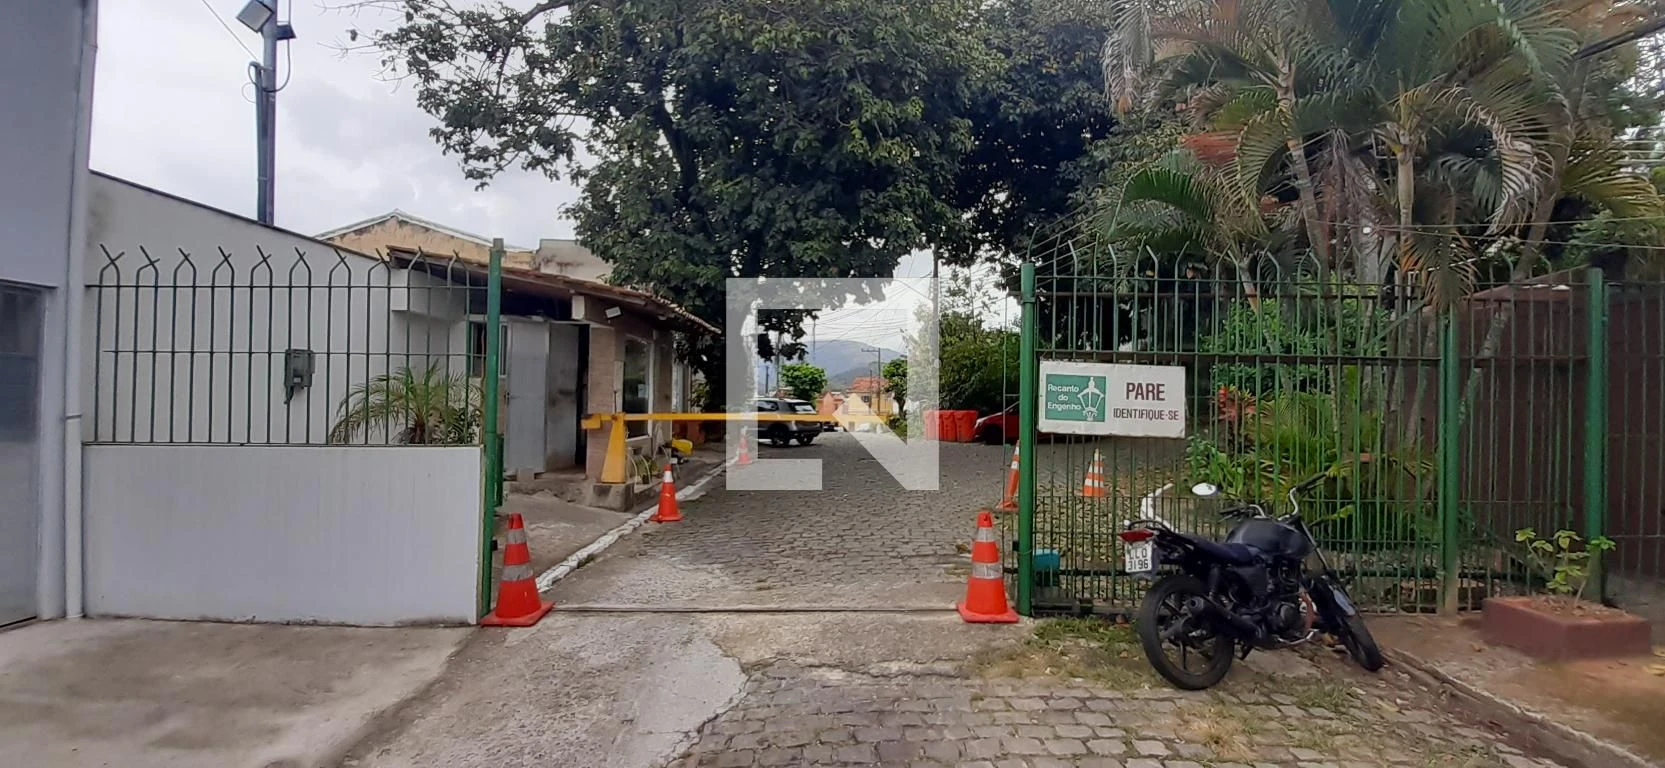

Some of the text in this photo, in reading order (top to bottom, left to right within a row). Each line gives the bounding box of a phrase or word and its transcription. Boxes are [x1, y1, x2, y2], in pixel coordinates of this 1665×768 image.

[1047, 383, 1079, 393] Recanto
[1125, 382, 1166, 401] PARE
[1057, 393, 1069, 401] do
[1047, 402, 1082, 411] Engenho
[1113, 408, 1179, 421] IDENTIFIQUE-SE
[1128, 559, 1148, 570] 3196
